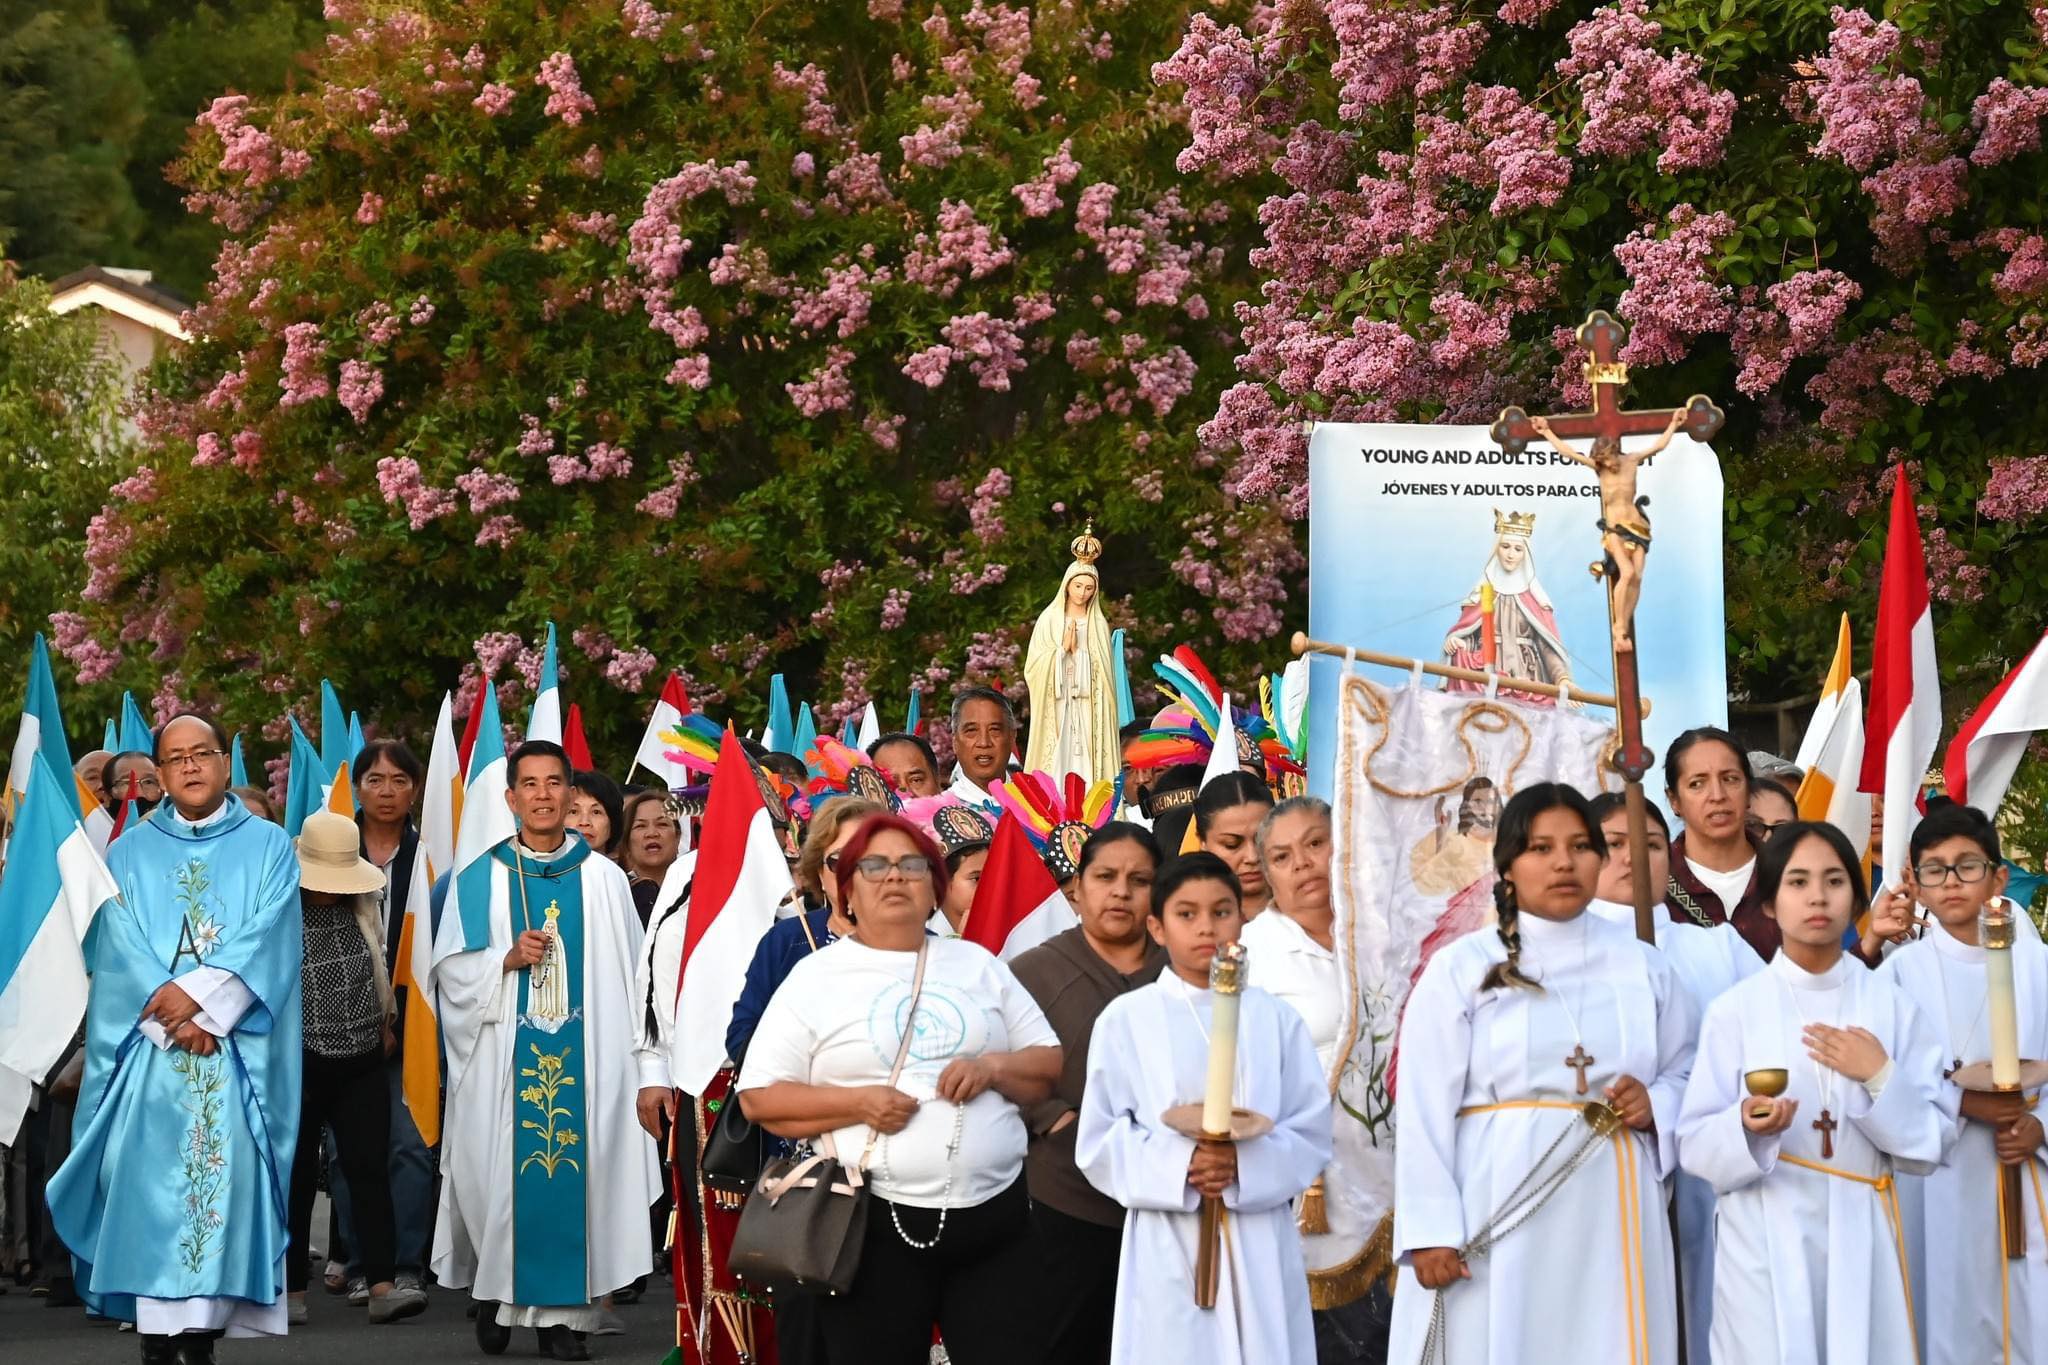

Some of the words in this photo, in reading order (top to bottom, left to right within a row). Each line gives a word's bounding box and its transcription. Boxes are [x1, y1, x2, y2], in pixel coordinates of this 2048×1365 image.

[1361, 449, 1428, 464] YOUNG
[1432, 450, 1472, 465] AND
[1475, 450, 1547, 465] ADULTS
[1381, 480, 1448, 495] JÓVENES
[1450, 483, 1461, 496] Y
[1463, 484, 1534, 496] ADULTOS
[1537, 485, 1578, 497] PARA
